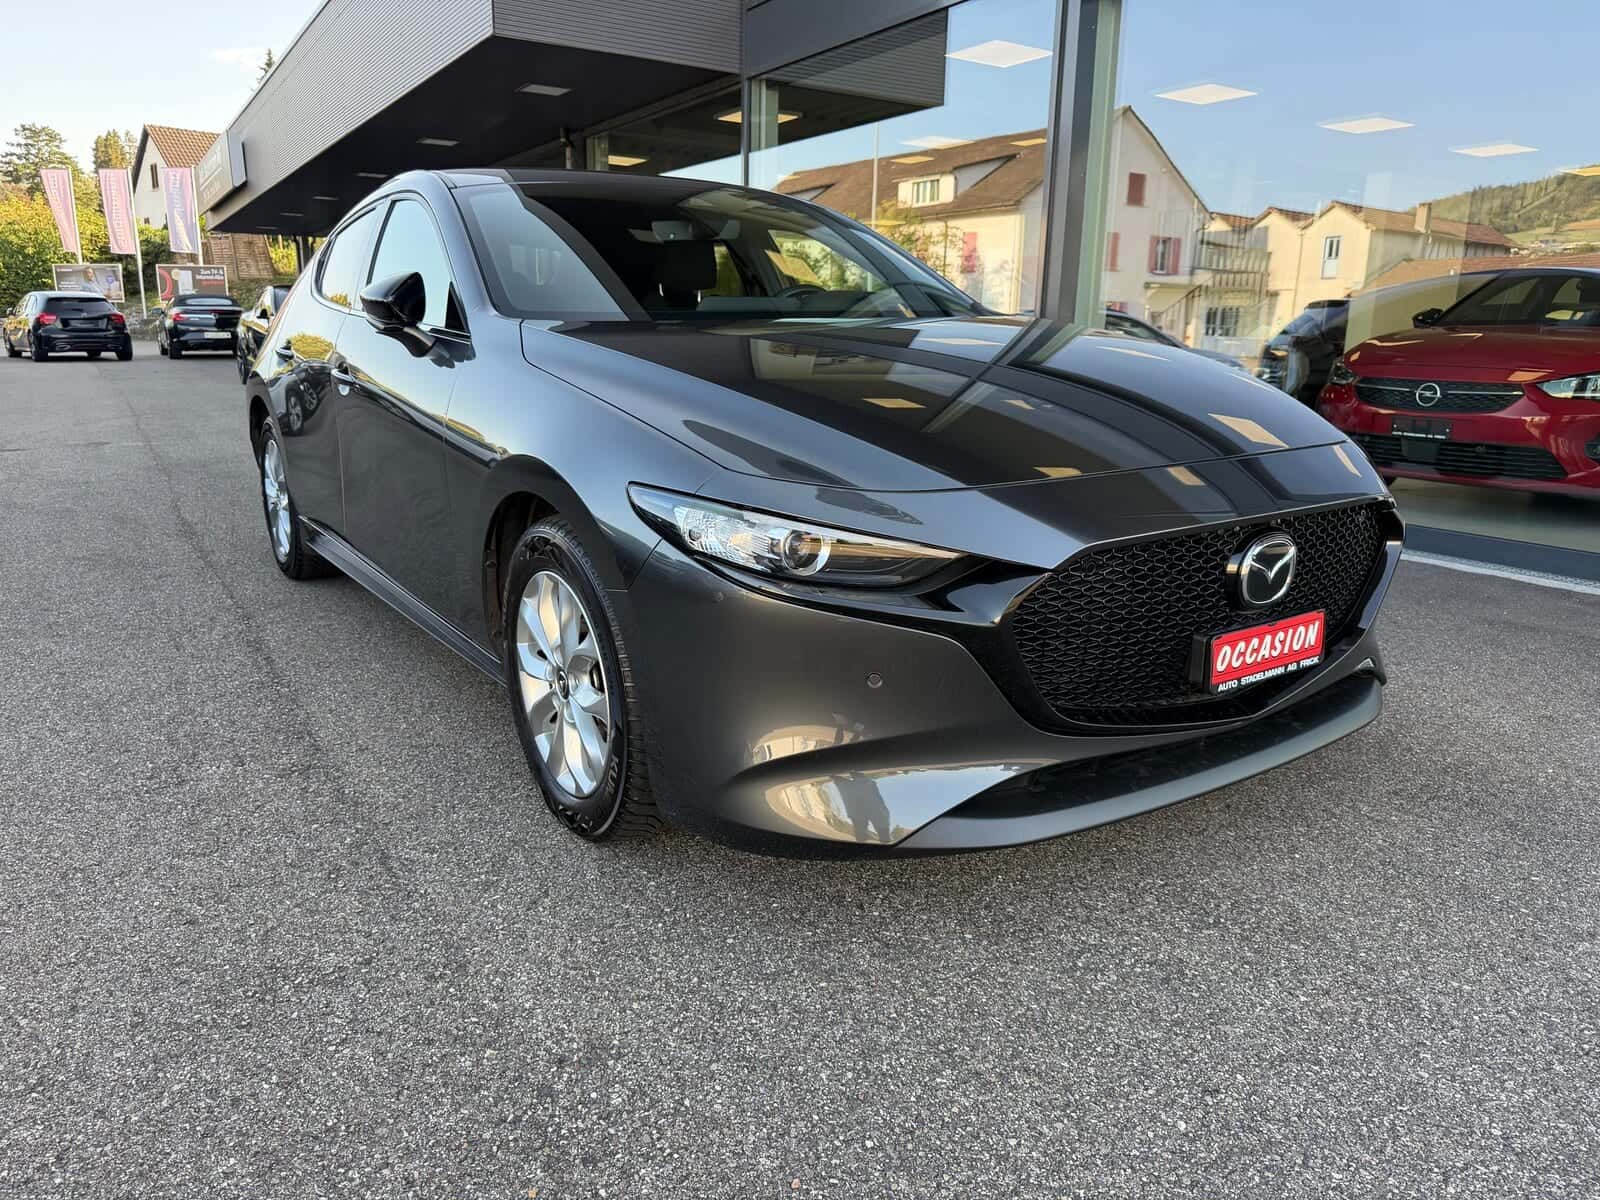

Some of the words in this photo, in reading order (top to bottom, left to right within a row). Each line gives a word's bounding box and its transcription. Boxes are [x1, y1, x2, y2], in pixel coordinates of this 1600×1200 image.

[1216, 620, 1320, 673] OCCASION
[1217, 679, 1238, 692] AUTO
[1240, 668, 1285, 685] STADELMANN
[1286, 663, 1297, 672] AG
[1299, 656, 1320, 669] FRICK
